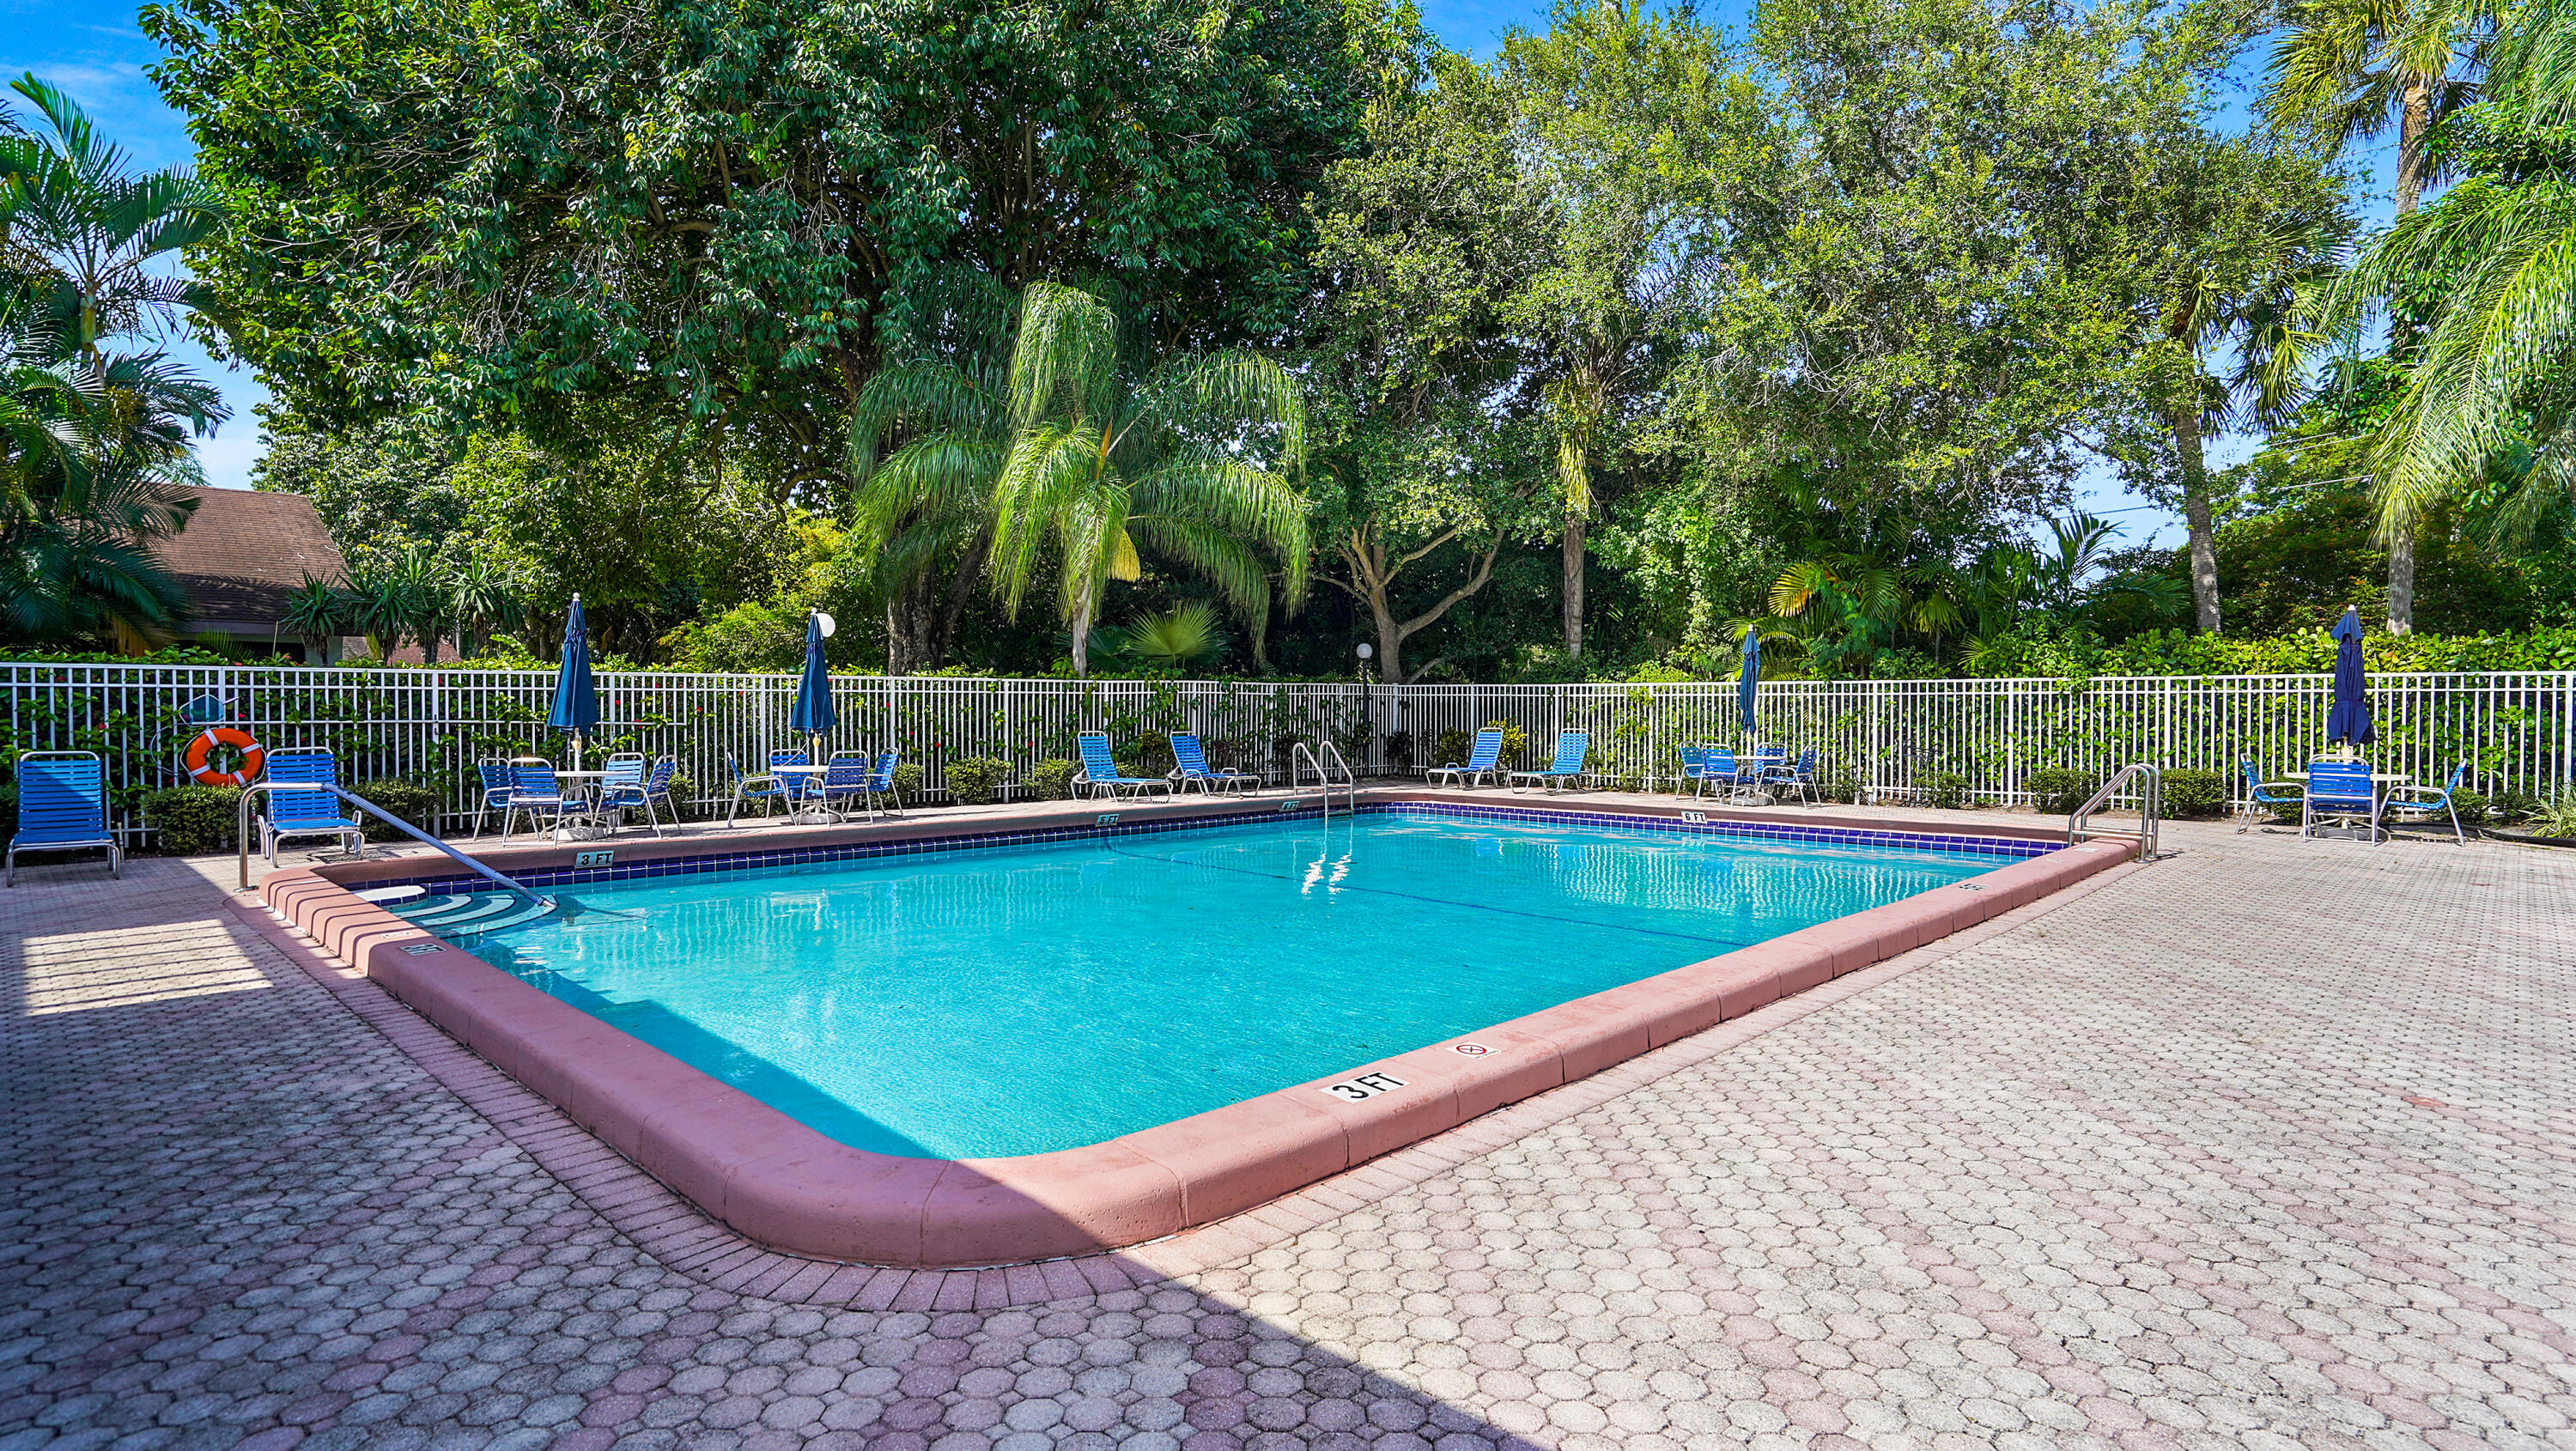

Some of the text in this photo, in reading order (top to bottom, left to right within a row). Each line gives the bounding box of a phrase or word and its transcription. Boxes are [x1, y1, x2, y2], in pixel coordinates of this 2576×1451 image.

[1099, 816, 1106, 824] 6
[1685, 812, 1691, 821] 6
[580, 854, 590, 865] 3
[1332, 1072, 1406, 1099] 3 FT
